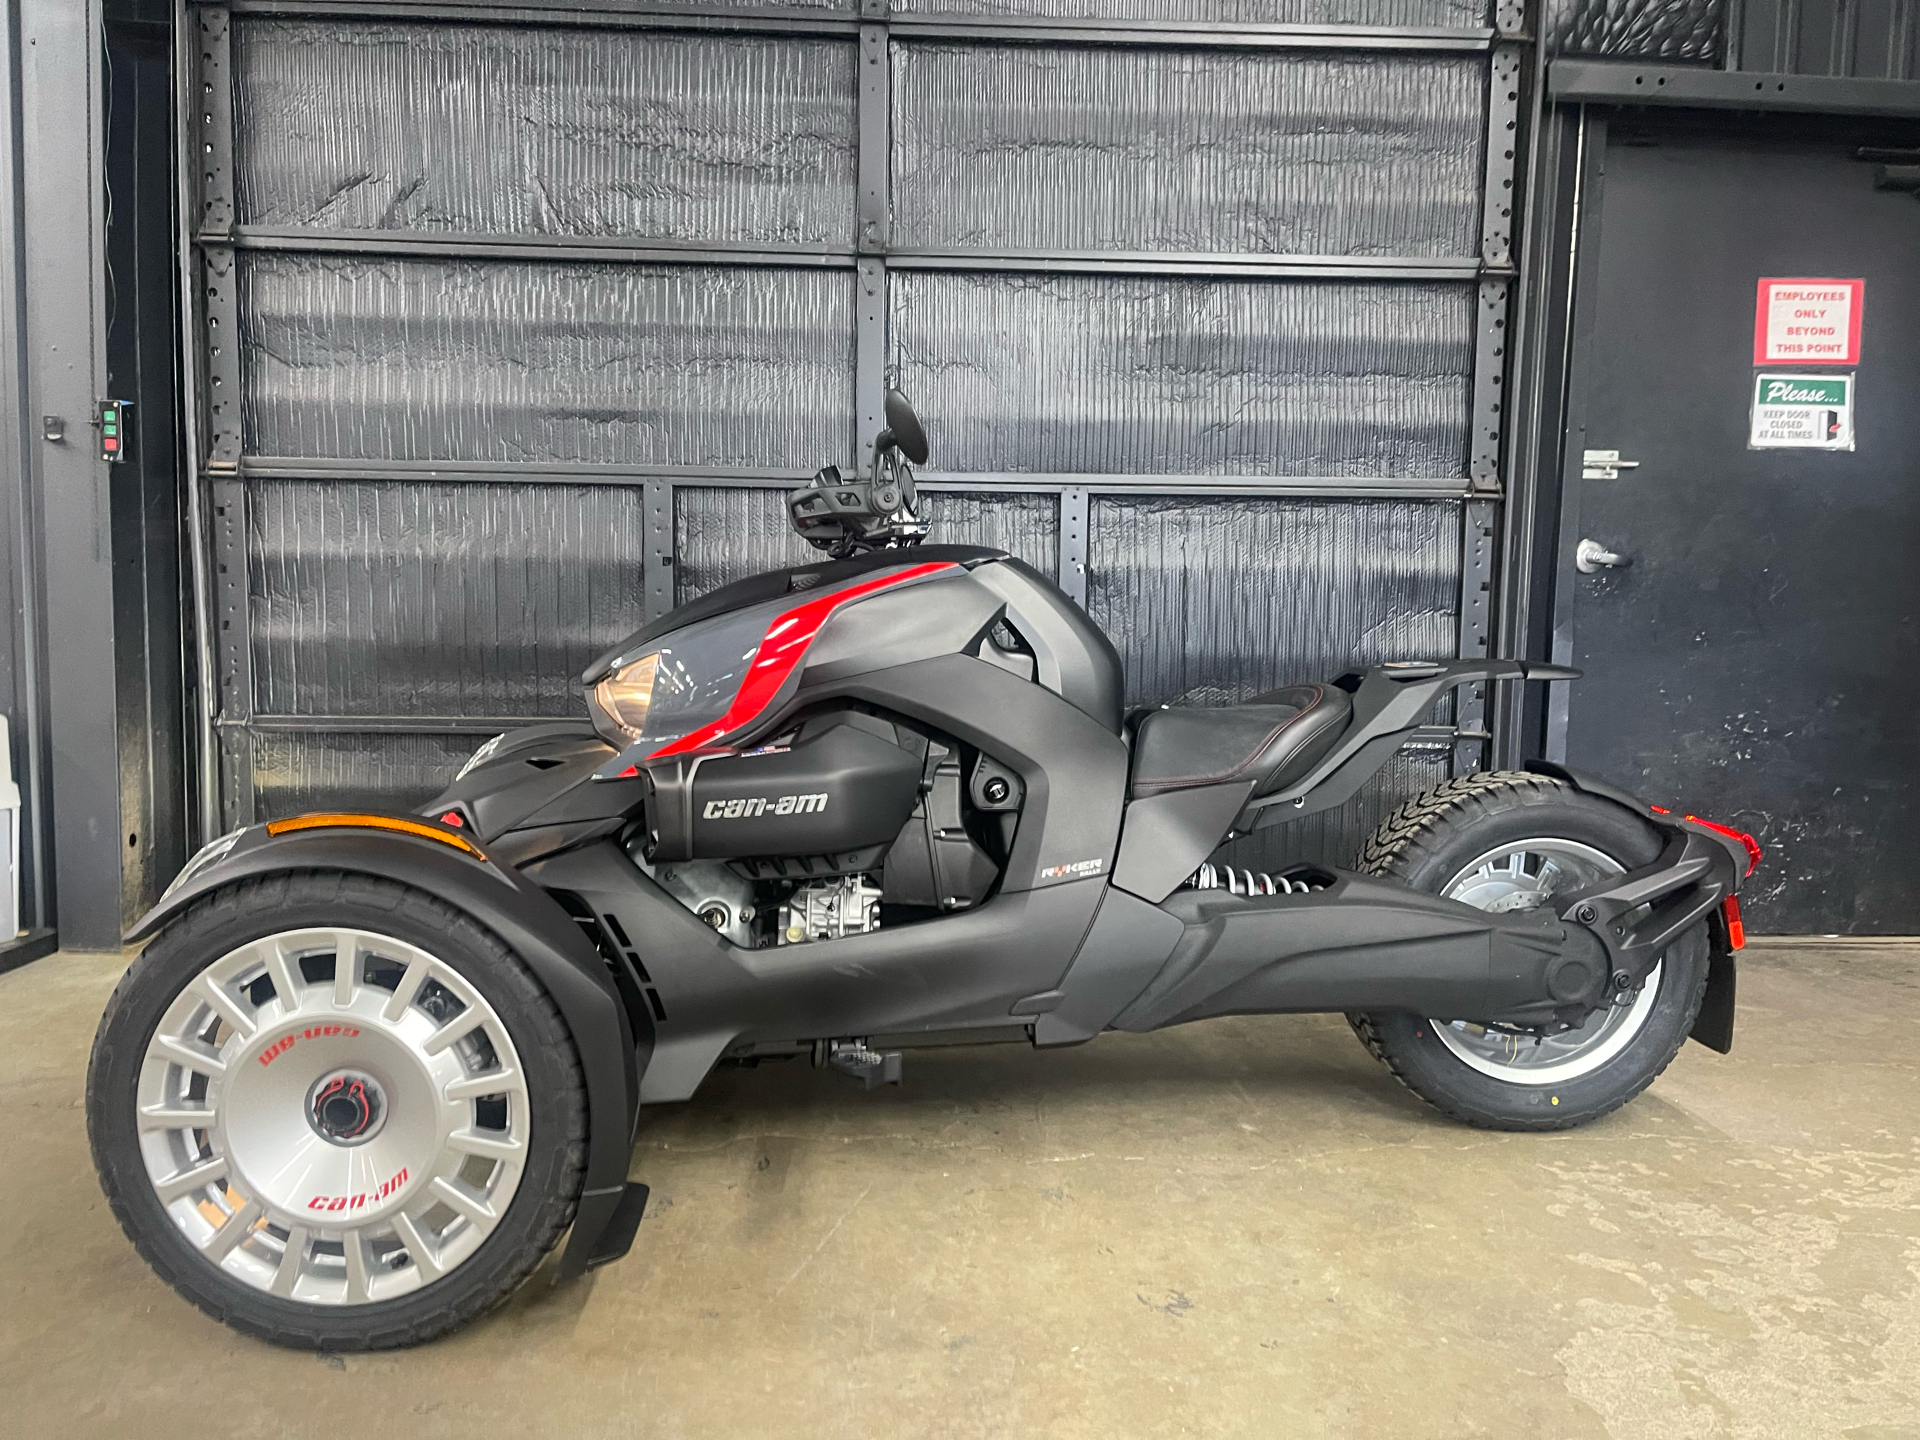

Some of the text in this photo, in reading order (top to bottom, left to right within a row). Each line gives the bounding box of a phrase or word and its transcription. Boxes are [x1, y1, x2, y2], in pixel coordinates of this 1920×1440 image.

[1774, 291, 1846, 302] EMPLOYEES
[1794, 309, 1827, 319] ONLY
[1787, 326, 1835, 336] BEYOND
[1776, 343, 1843, 353] THIS POINT
[1766, 381, 1838, 402] Please...
[1763, 410, 1811, 419] KEEP DOOR
[1770, 420, 1803, 429] CLOSED
[1758, 430, 1813, 440] AT ALL TIMES
[702, 792, 829, 820] can-am
[1041, 858, 1103, 878] RYKER
[307, 1166, 409, 1211] can-am
